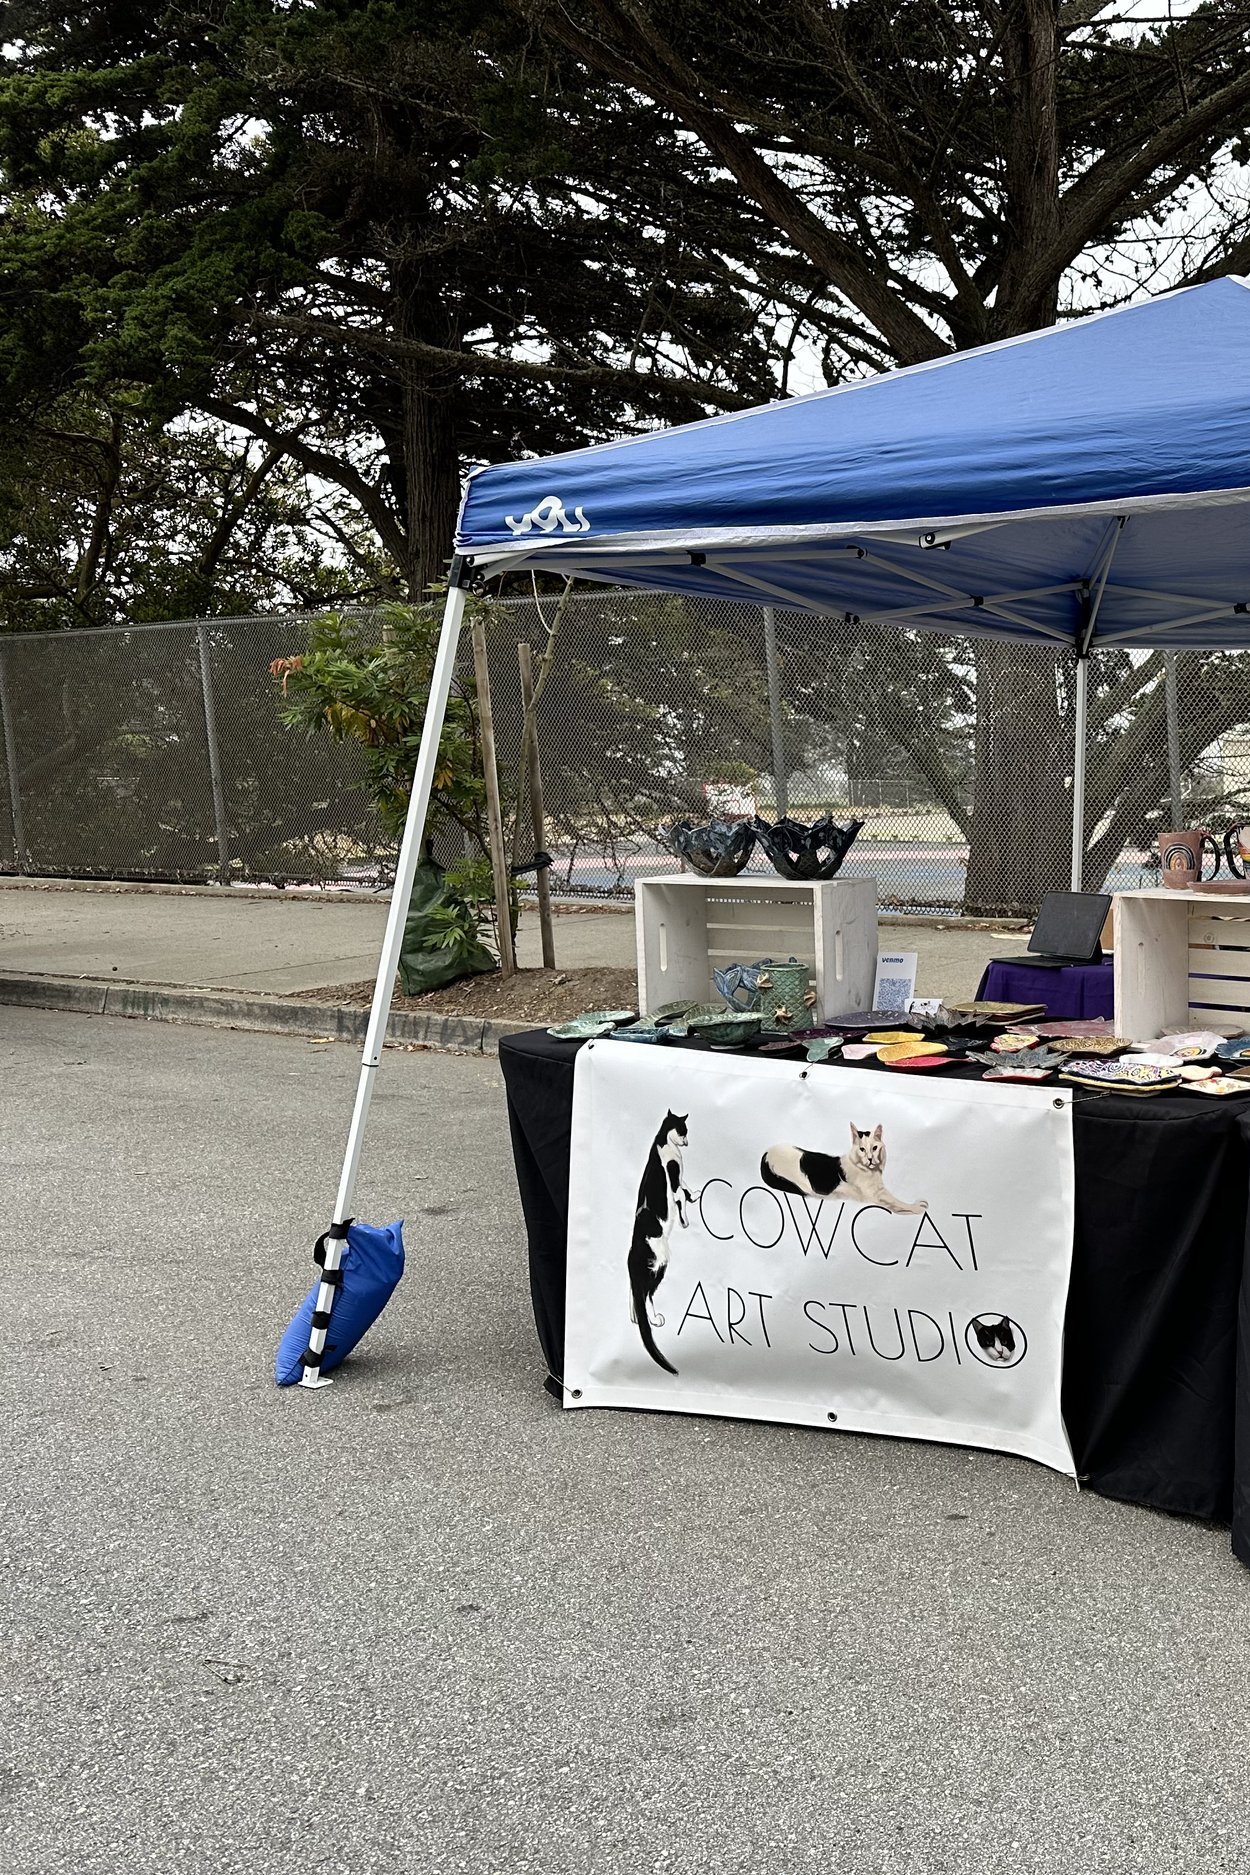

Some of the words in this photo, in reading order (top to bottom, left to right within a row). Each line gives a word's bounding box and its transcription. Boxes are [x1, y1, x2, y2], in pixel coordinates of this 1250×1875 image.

[699, 1178, 983, 1271] COWCAT
[677, 1281, 773, 1348] ART
[803, 1301, 1028, 1369] STUDIO
